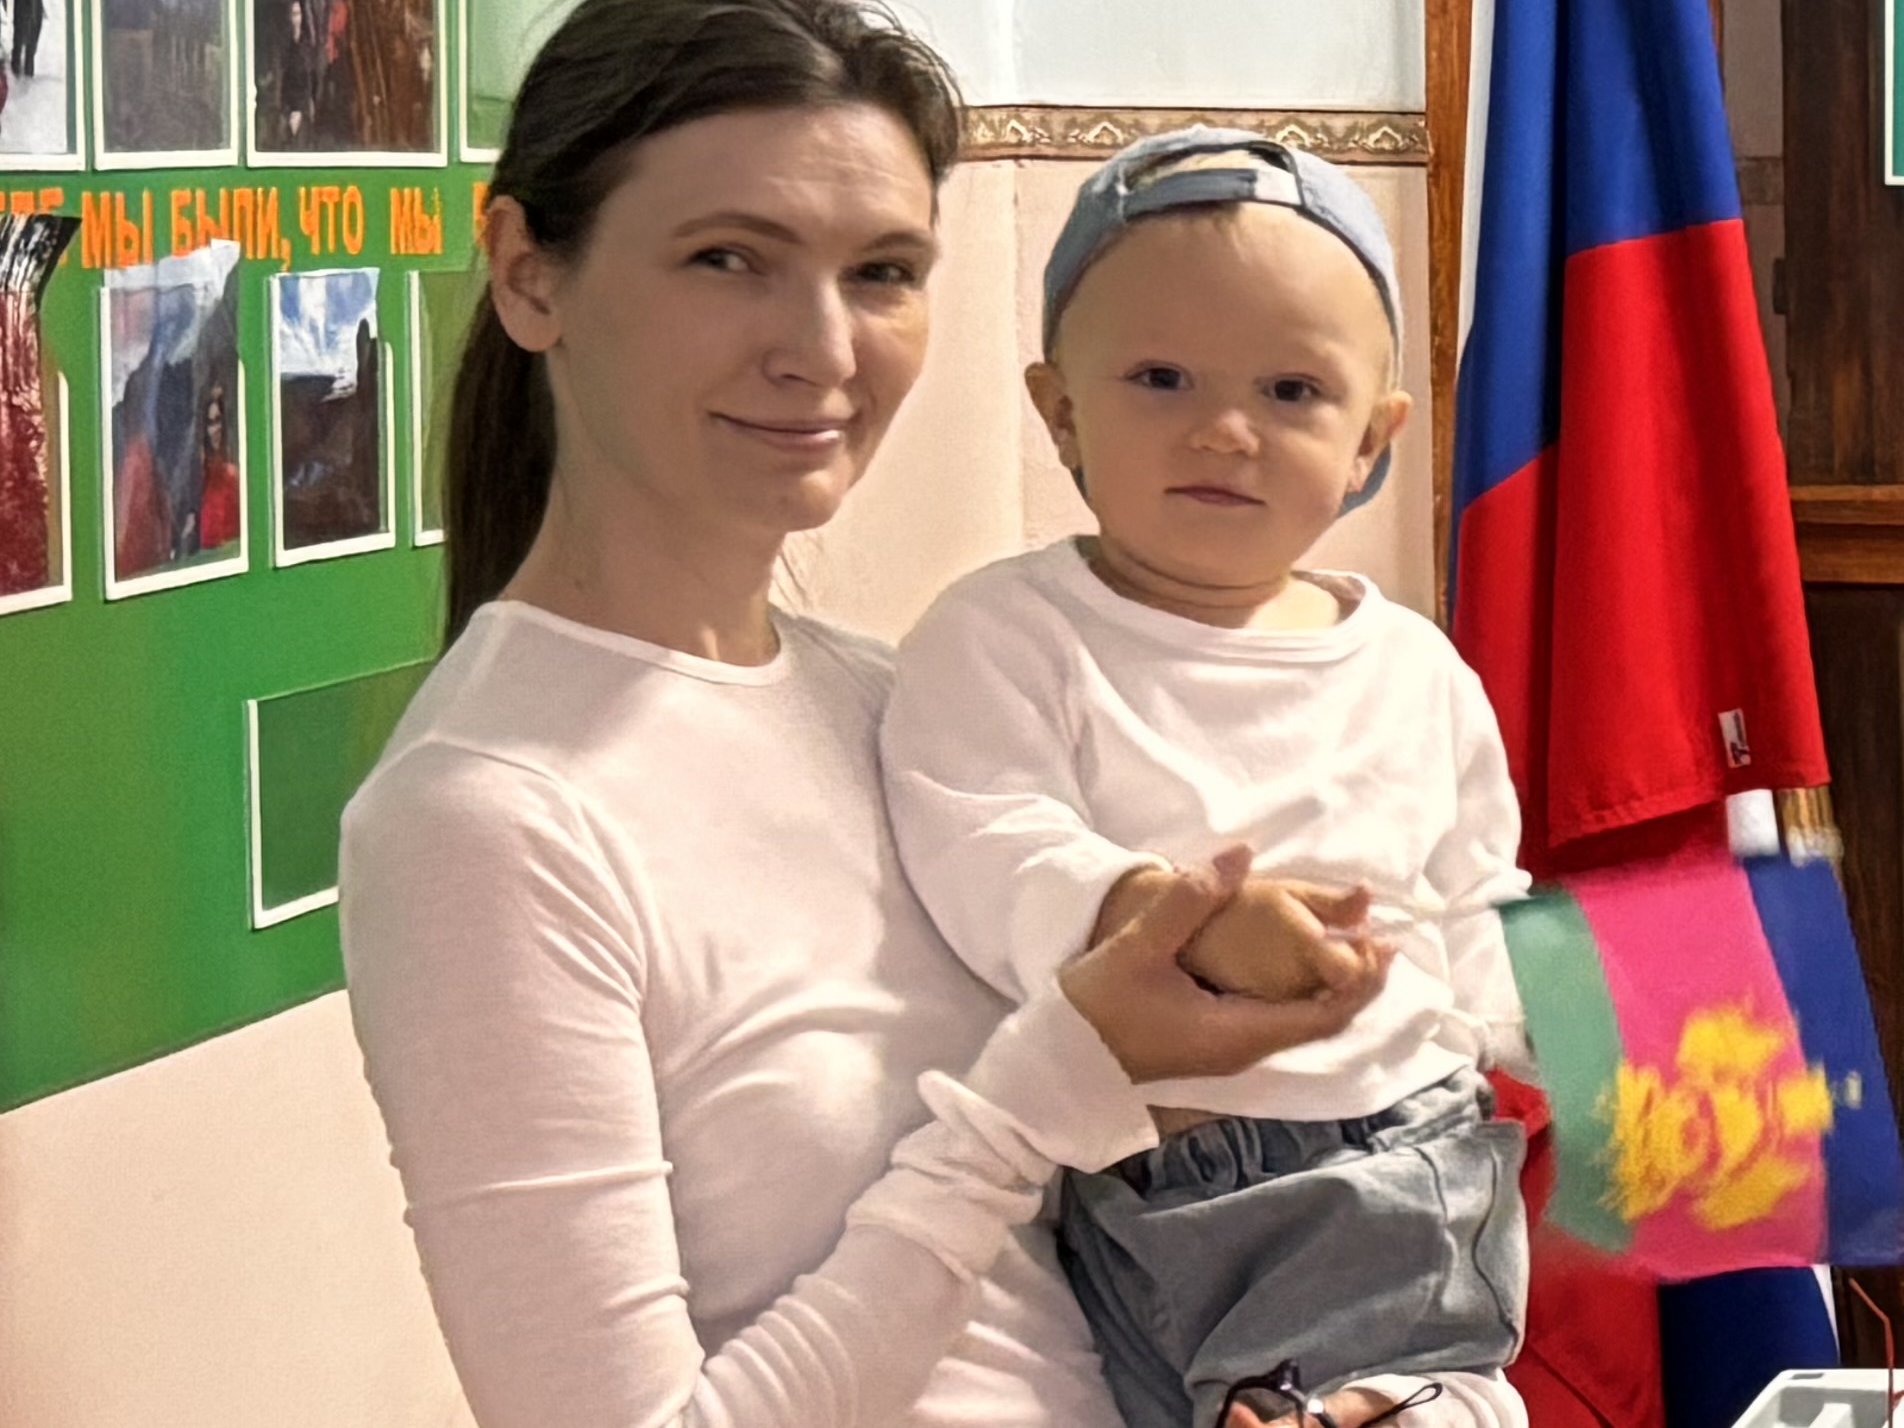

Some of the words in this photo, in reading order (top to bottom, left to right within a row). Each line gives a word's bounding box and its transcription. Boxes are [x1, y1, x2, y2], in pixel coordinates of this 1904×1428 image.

[81, 188, 154, 269] МЫ
[298, 184, 365, 256] ЧТО
[389, 187, 443, 255] МЫ
